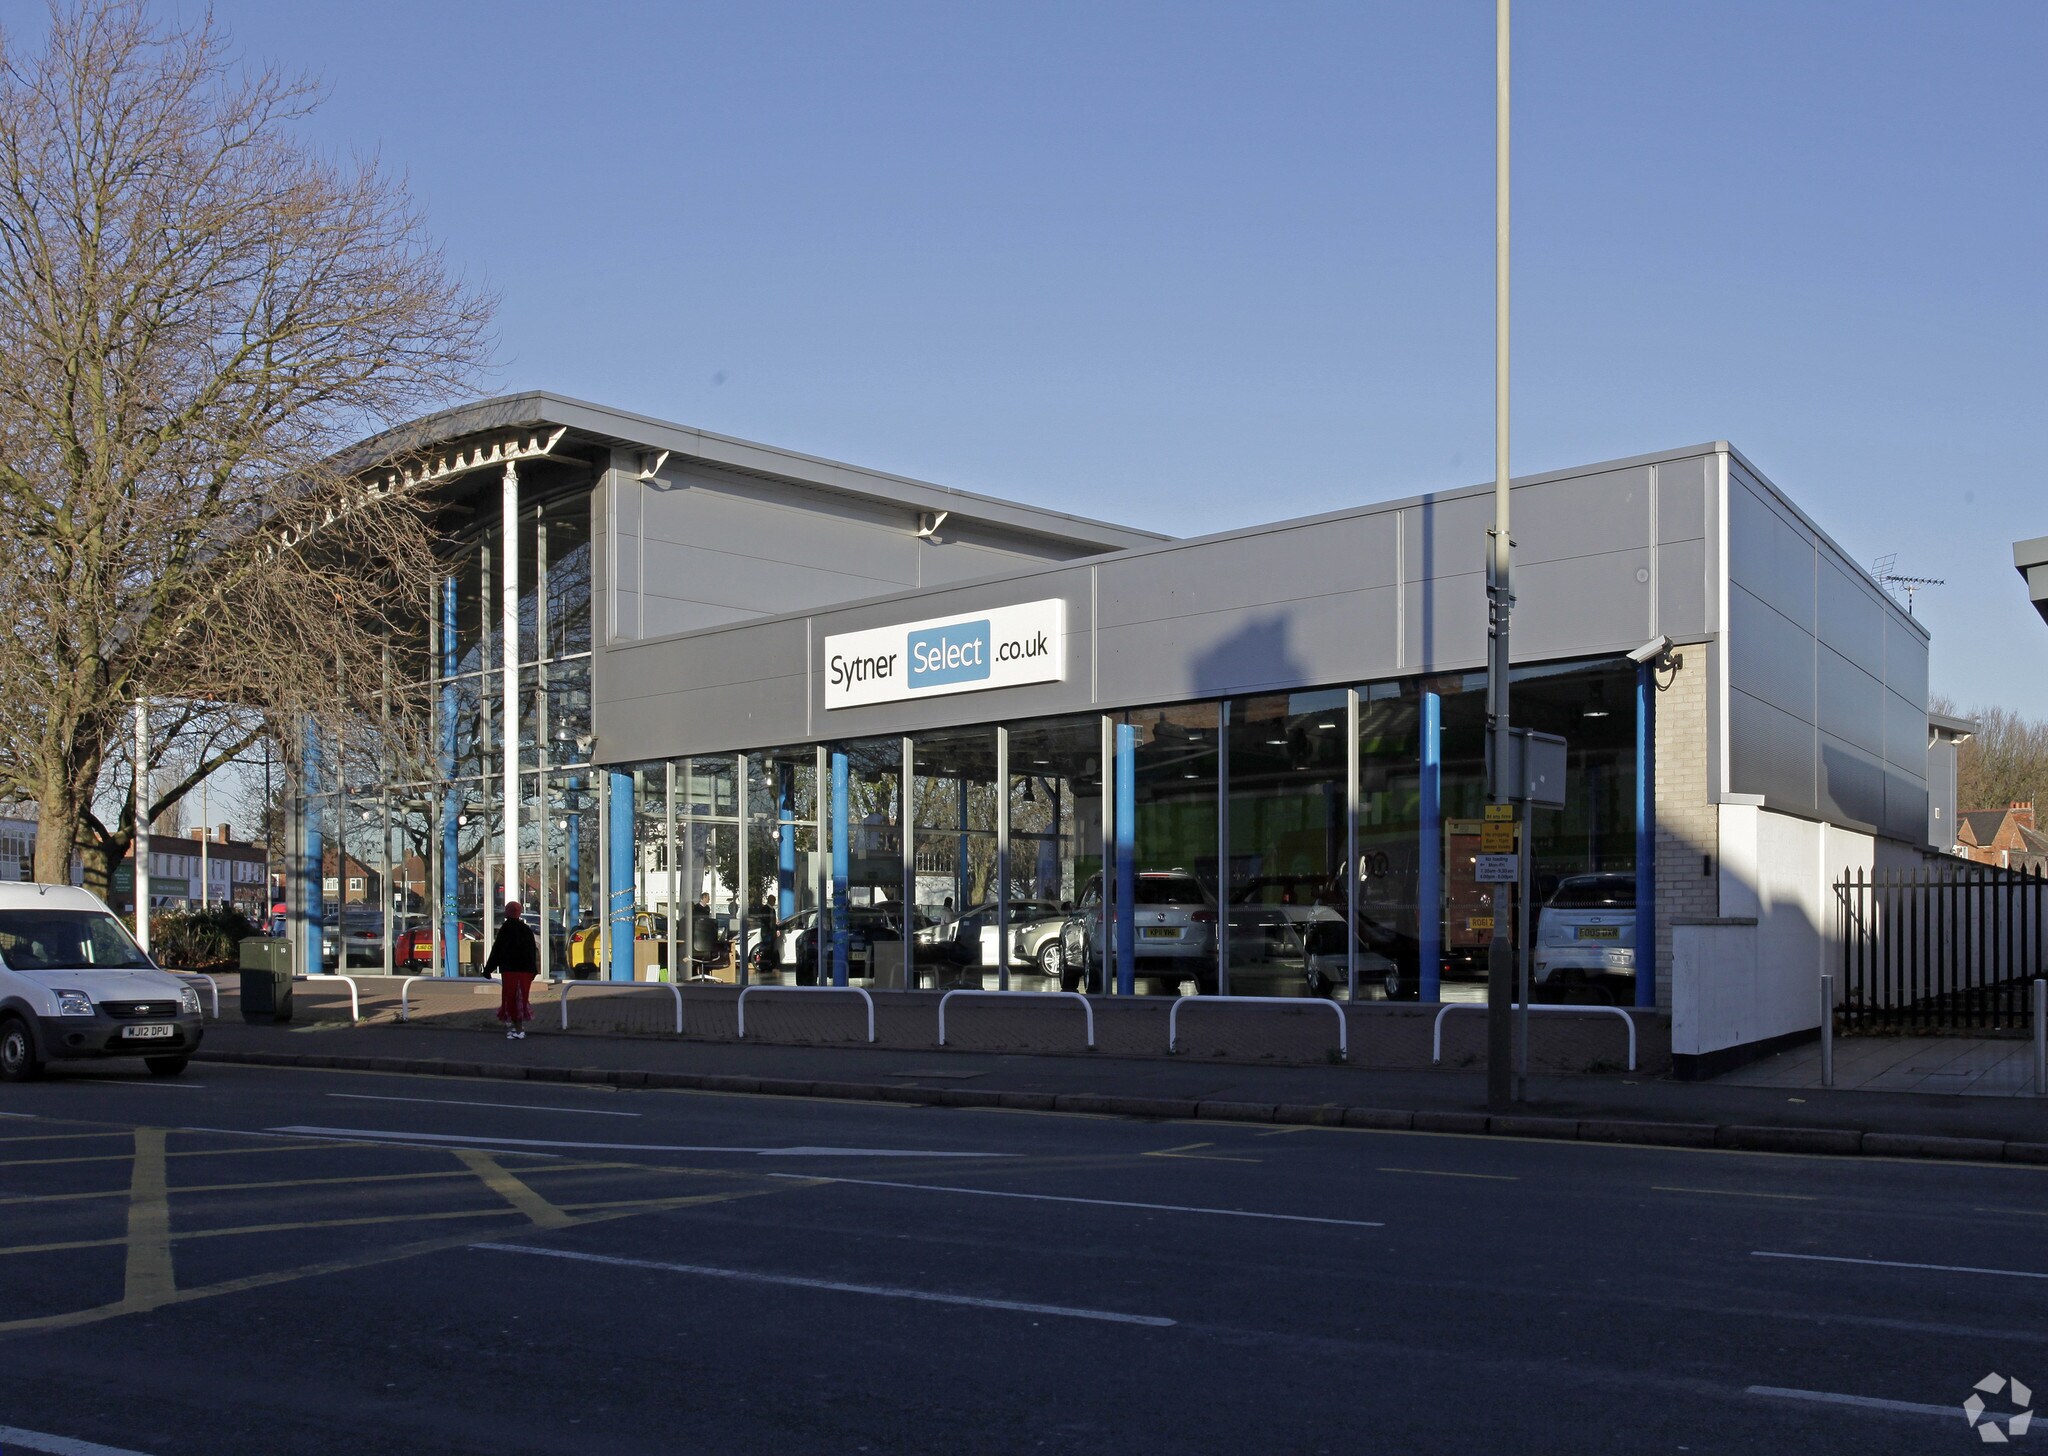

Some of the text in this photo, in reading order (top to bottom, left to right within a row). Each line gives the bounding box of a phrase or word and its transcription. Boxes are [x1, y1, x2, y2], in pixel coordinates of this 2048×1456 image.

[830, 630, 1048, 692] Sytner Select .co.uk
[128, 1026, 168, 1036] MJ12 DPU
